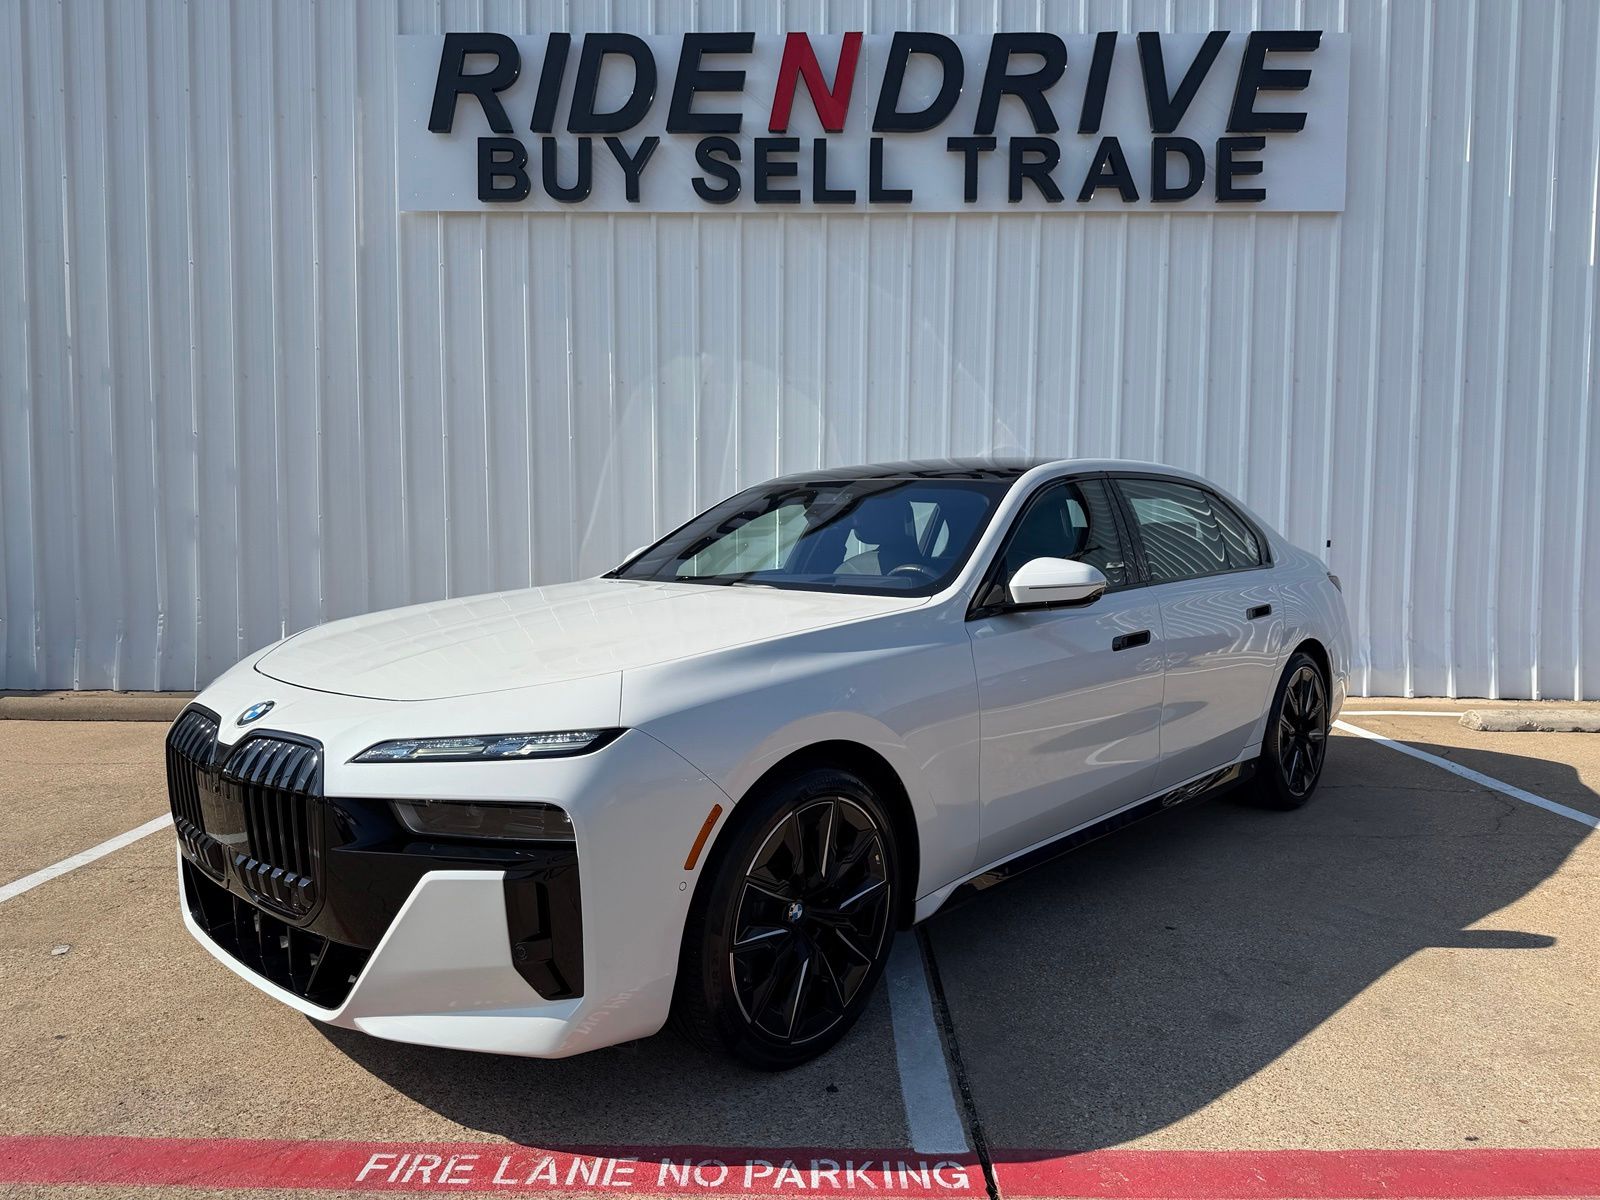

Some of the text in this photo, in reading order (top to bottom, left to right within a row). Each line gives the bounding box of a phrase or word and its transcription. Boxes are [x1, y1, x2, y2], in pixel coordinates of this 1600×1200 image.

[477, 136, 1267, 204] BUY SELL TRADE
[355, 1153, 970, 1189] FIRE LANE NO PARKING
